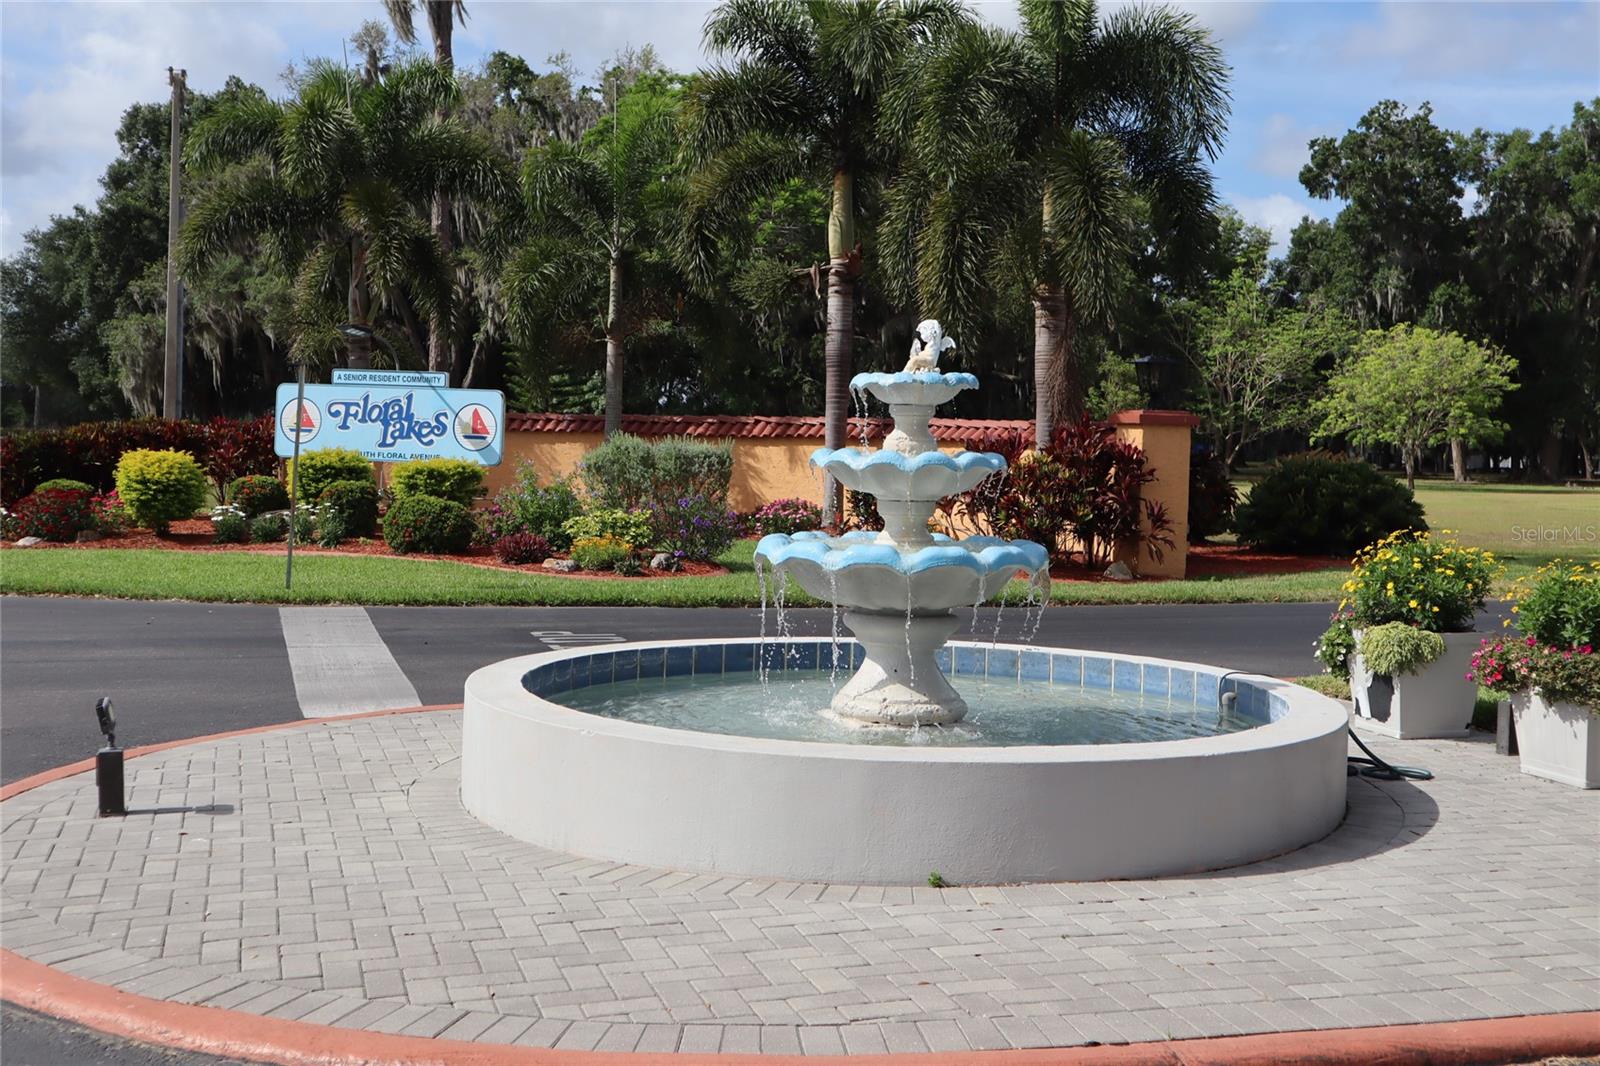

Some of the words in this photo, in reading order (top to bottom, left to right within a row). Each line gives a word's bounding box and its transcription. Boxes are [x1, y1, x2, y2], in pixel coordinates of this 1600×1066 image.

[369, 375, 400, 383] RESIDENT
[328, 393, 414, 430] Floral
[378, 451, 408, 459] FLORAL
